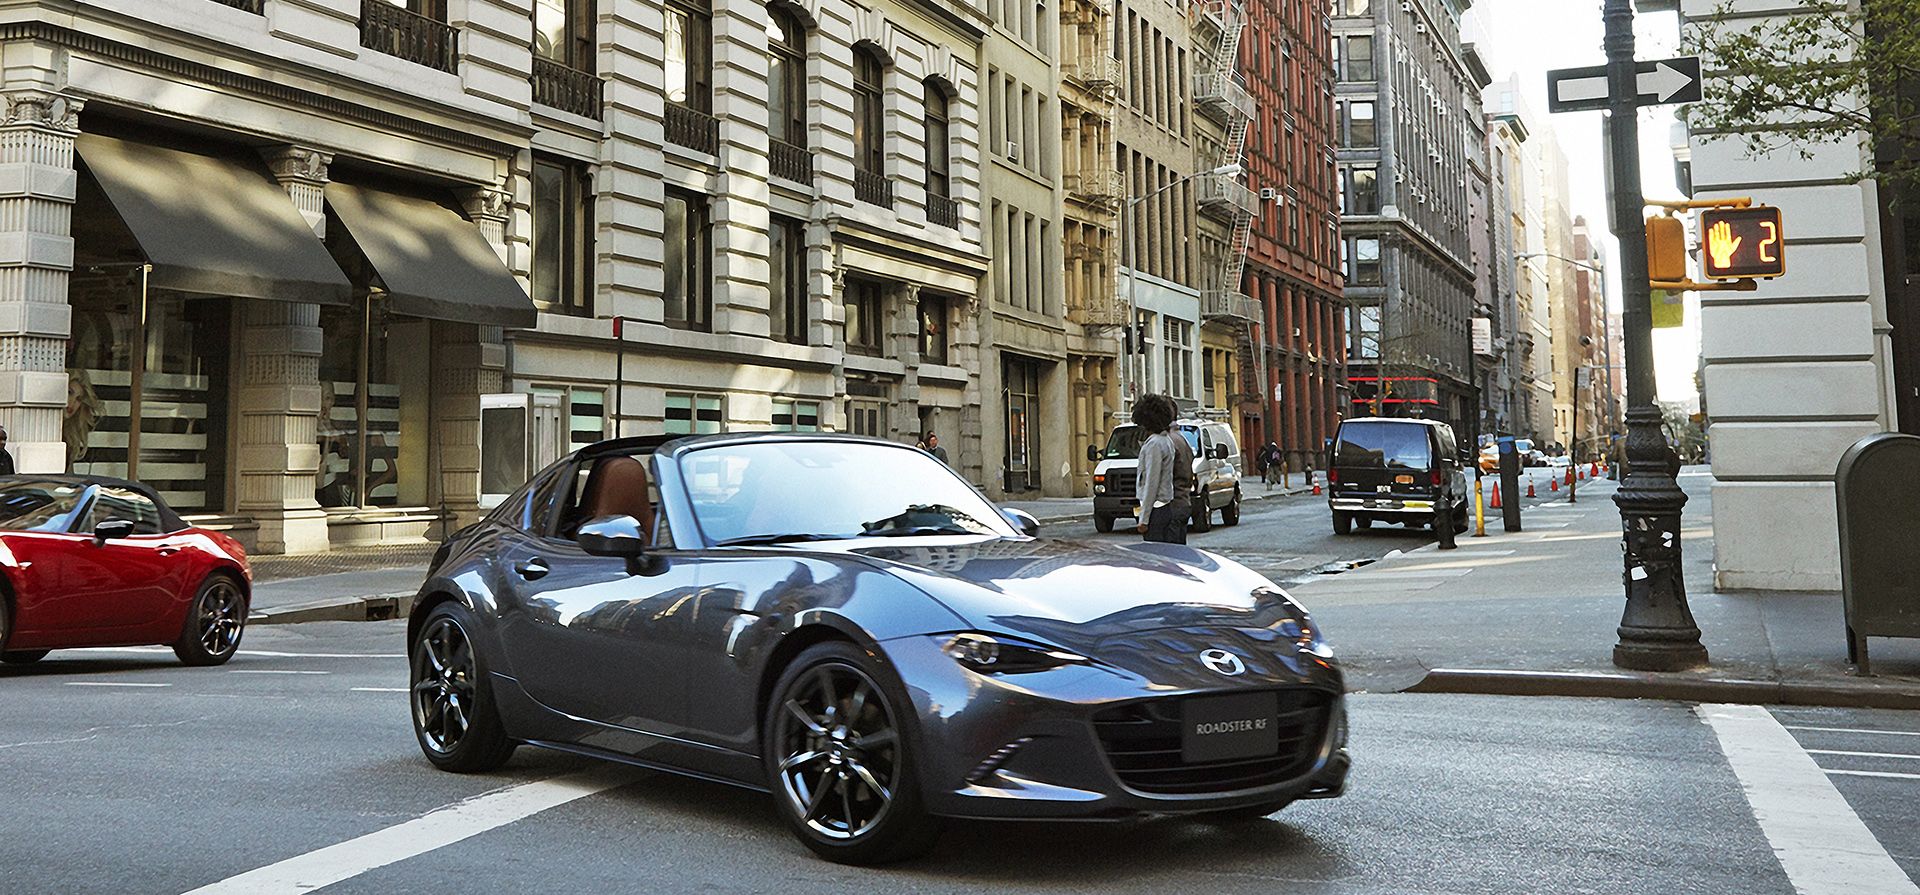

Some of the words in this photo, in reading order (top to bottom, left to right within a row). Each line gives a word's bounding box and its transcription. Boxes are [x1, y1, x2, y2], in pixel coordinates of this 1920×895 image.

[1759, 221, 1777, 262] 2
[1196, 720, 1253, 735] ROADSTER
[1255, 718, 1267, 730] RF
